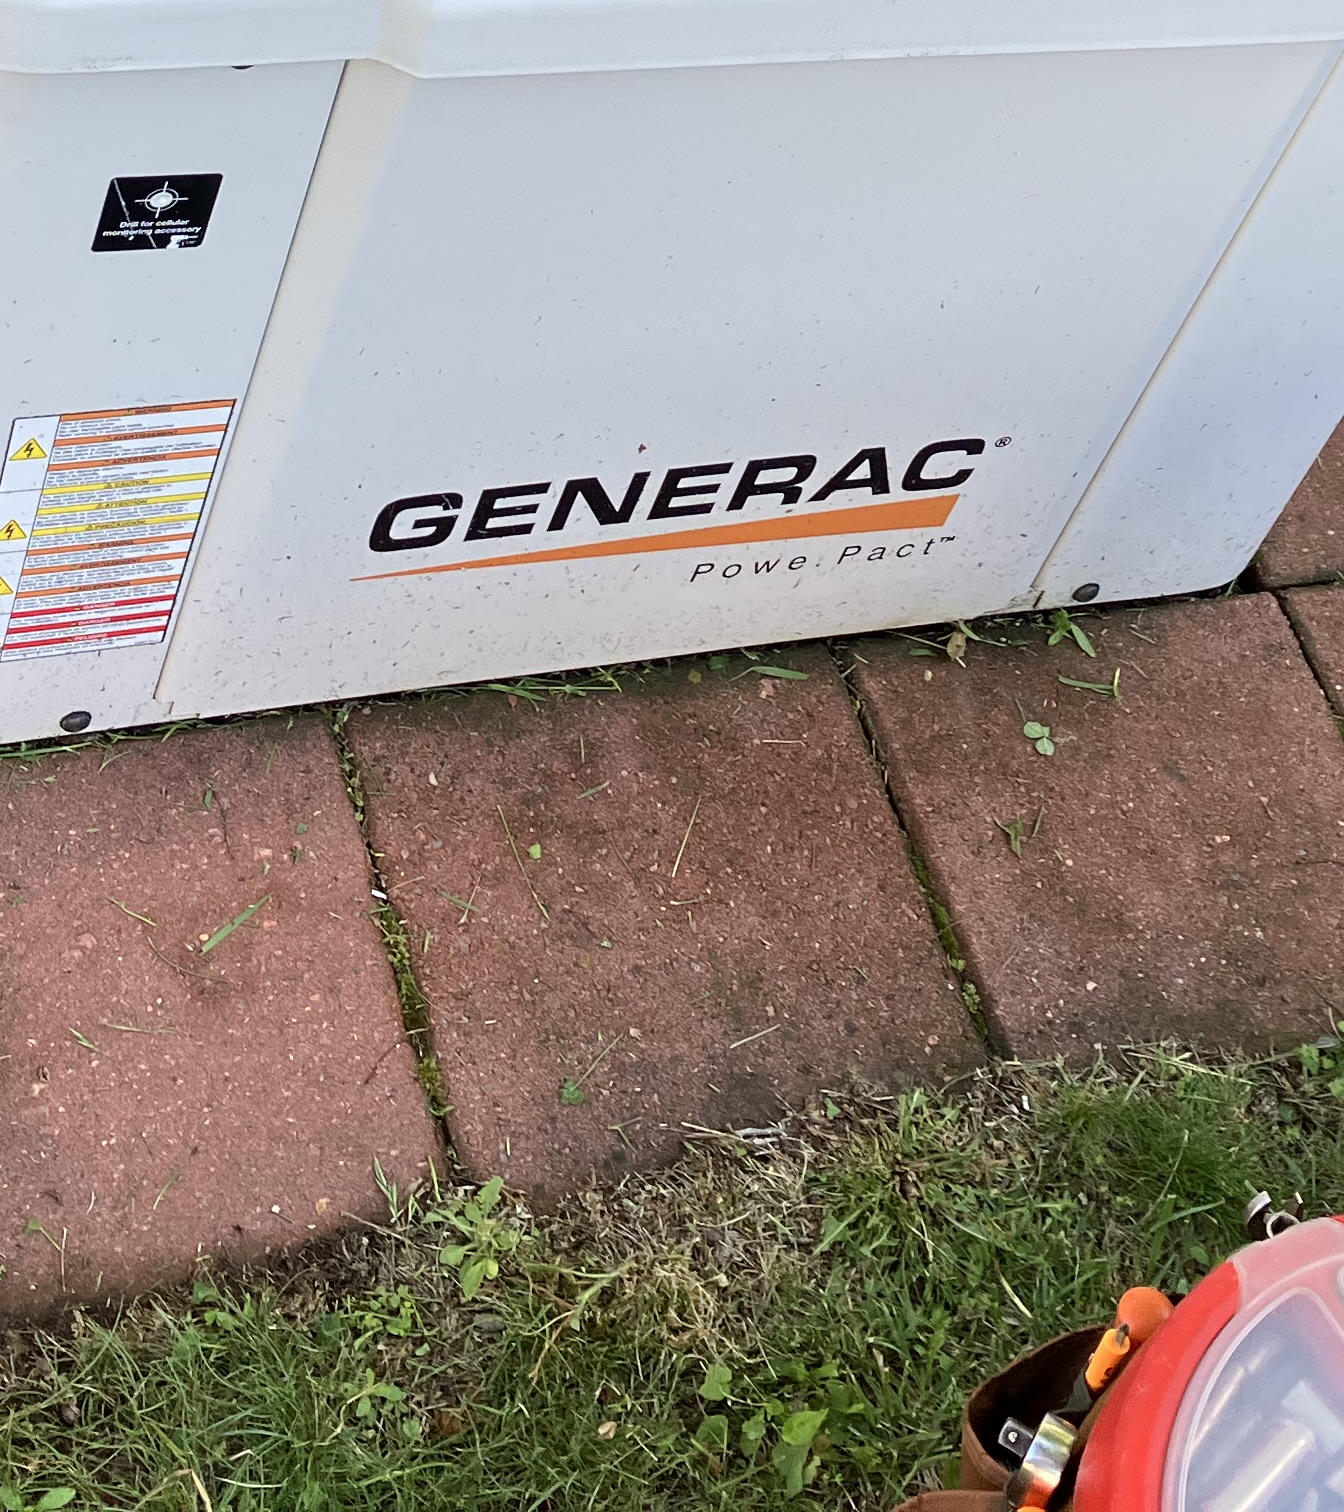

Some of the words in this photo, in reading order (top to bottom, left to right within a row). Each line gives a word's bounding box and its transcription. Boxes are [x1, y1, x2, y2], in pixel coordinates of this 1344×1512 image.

[155, 219, 190, 227] cellular
[102, 229, 153, 237] monitoring
[154, 226, 202, 234] accessory
[114, 479, 150, 488] CAUTION
[105, 499, 148, 508] ATTENTION
